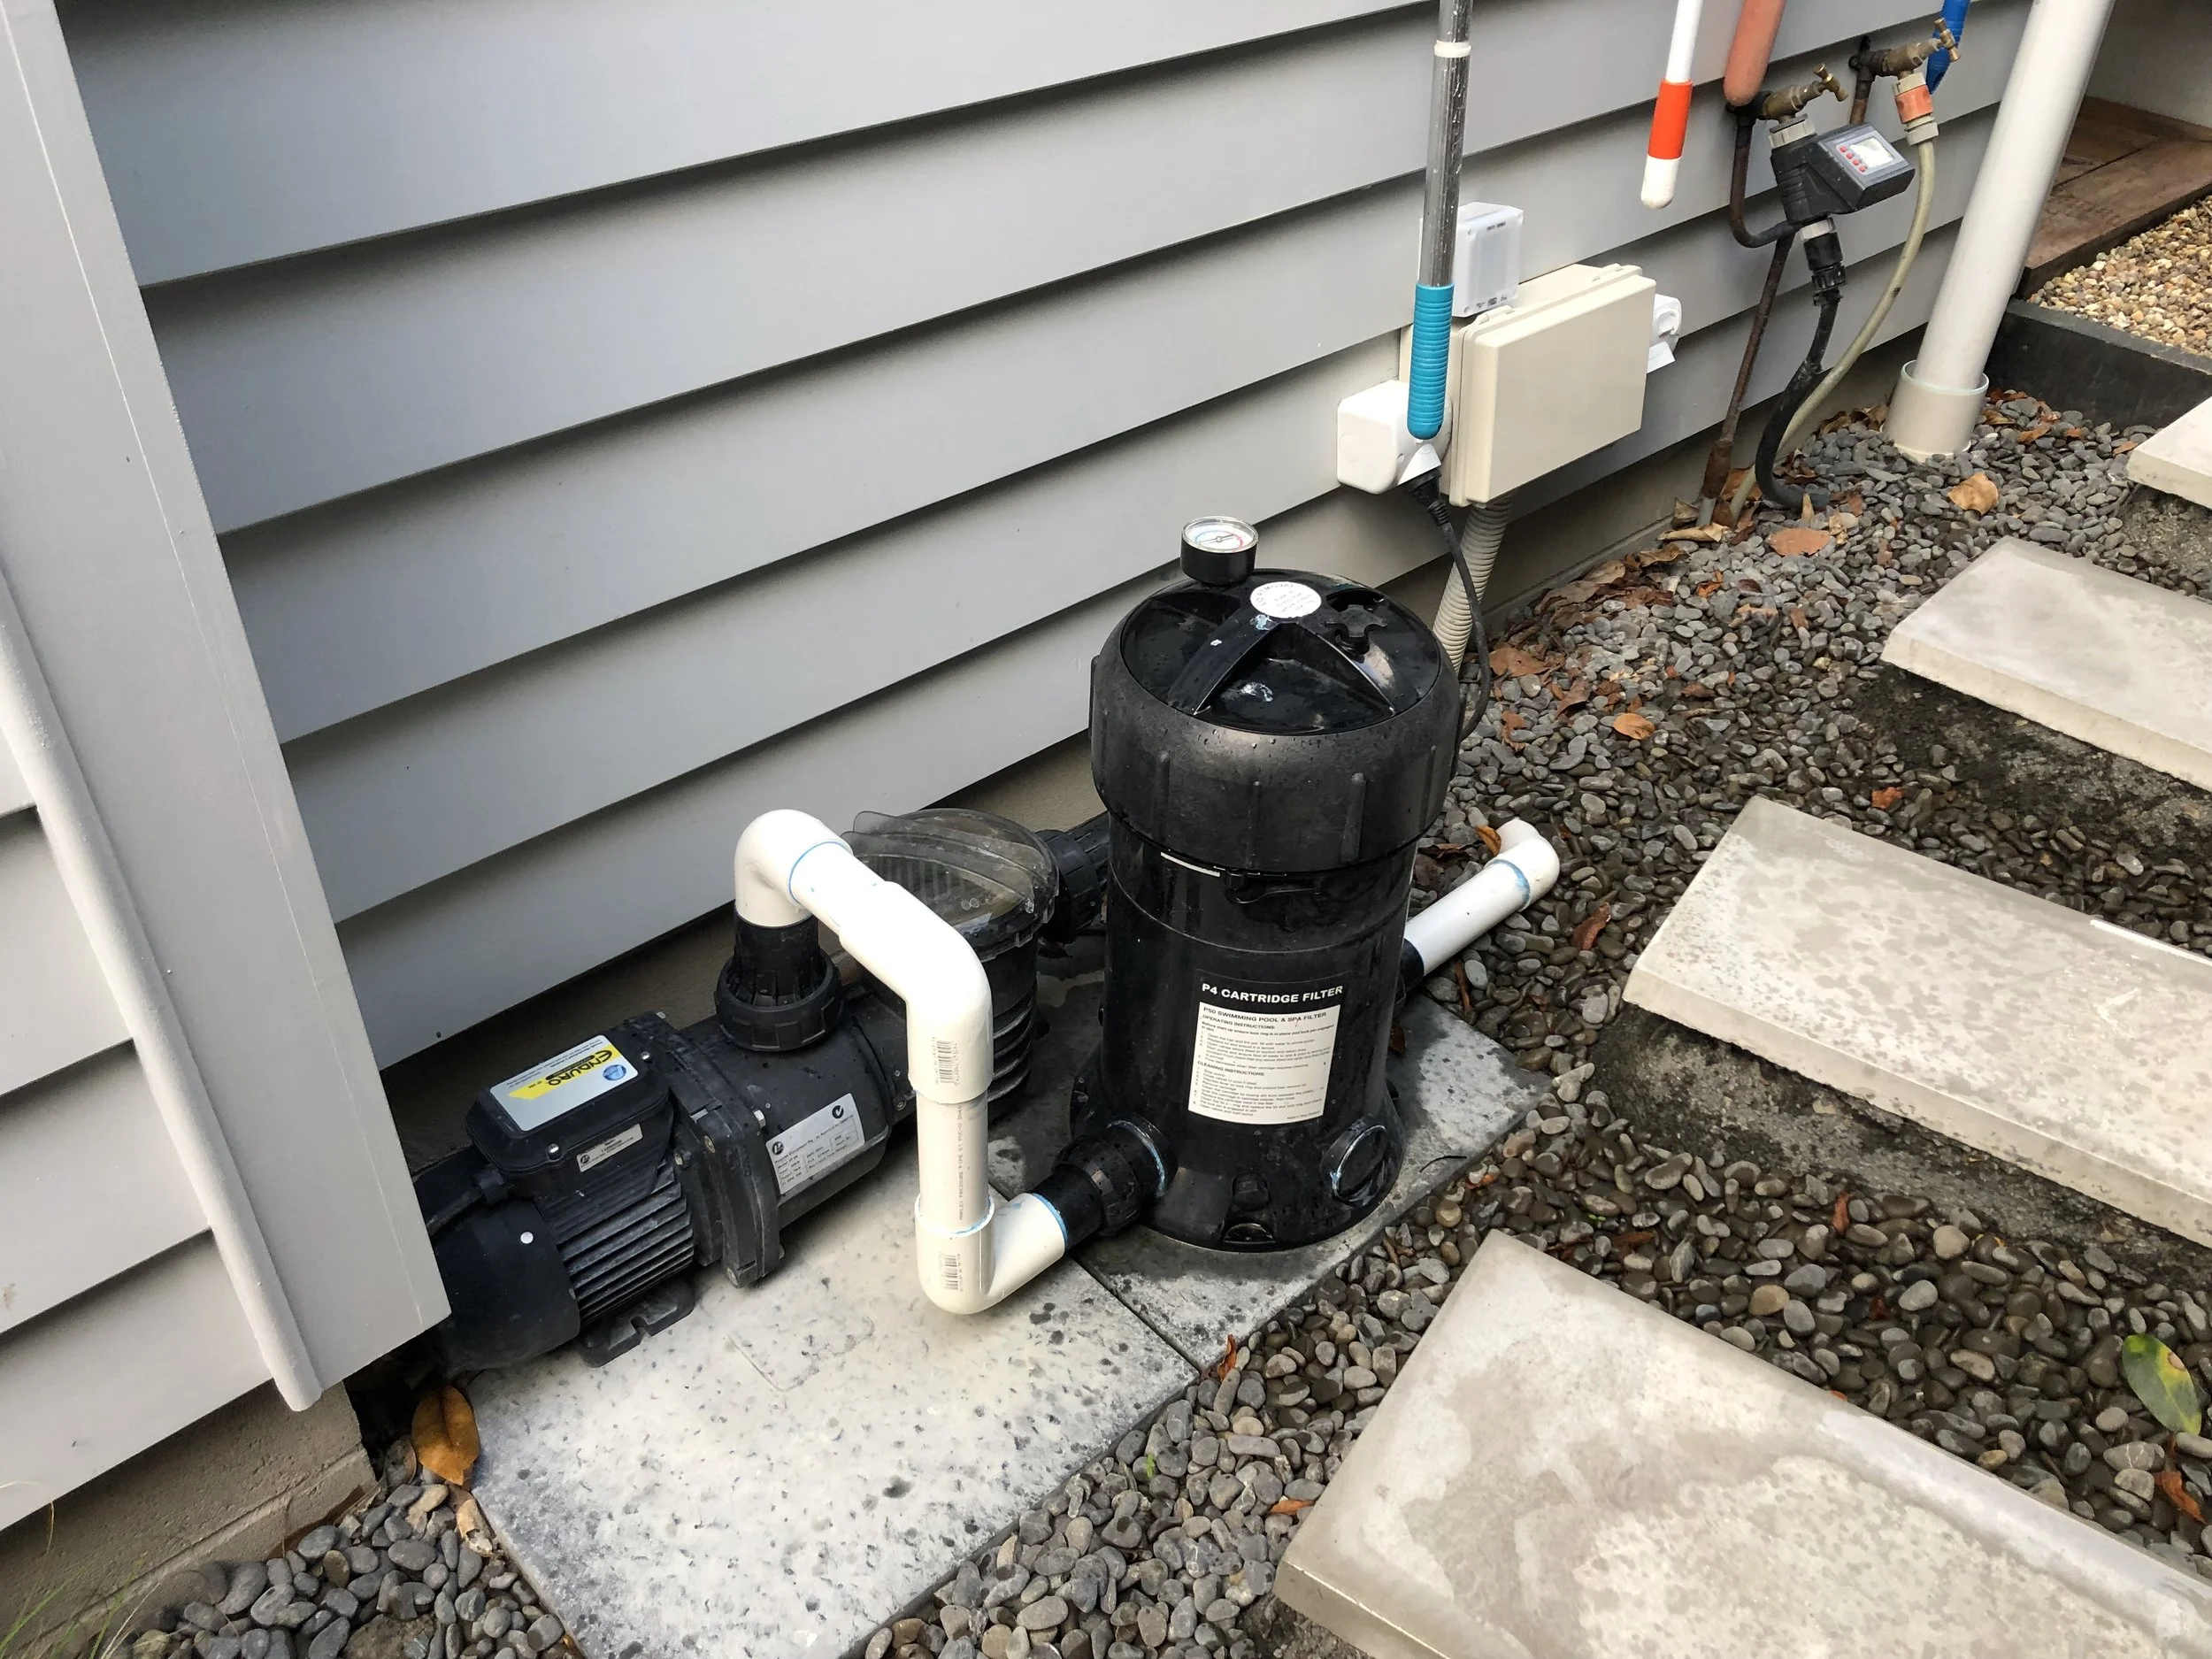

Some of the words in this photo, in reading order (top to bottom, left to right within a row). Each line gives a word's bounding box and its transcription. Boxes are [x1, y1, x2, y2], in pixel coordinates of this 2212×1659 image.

[1202, 983, 1217, 995] P4
[1221, 988, 1300, 1003] CARTRIDGE
[1302, 985, 1343, 1002] FILTER
[1202, 1014, 1233, 1025] OPERATING
[1217, 1010, 1257, 1022] SWIMMING
[548, 1049, 612, 1086] ENDURO
[1197, 1061, 1224, 1071] CLEANING
